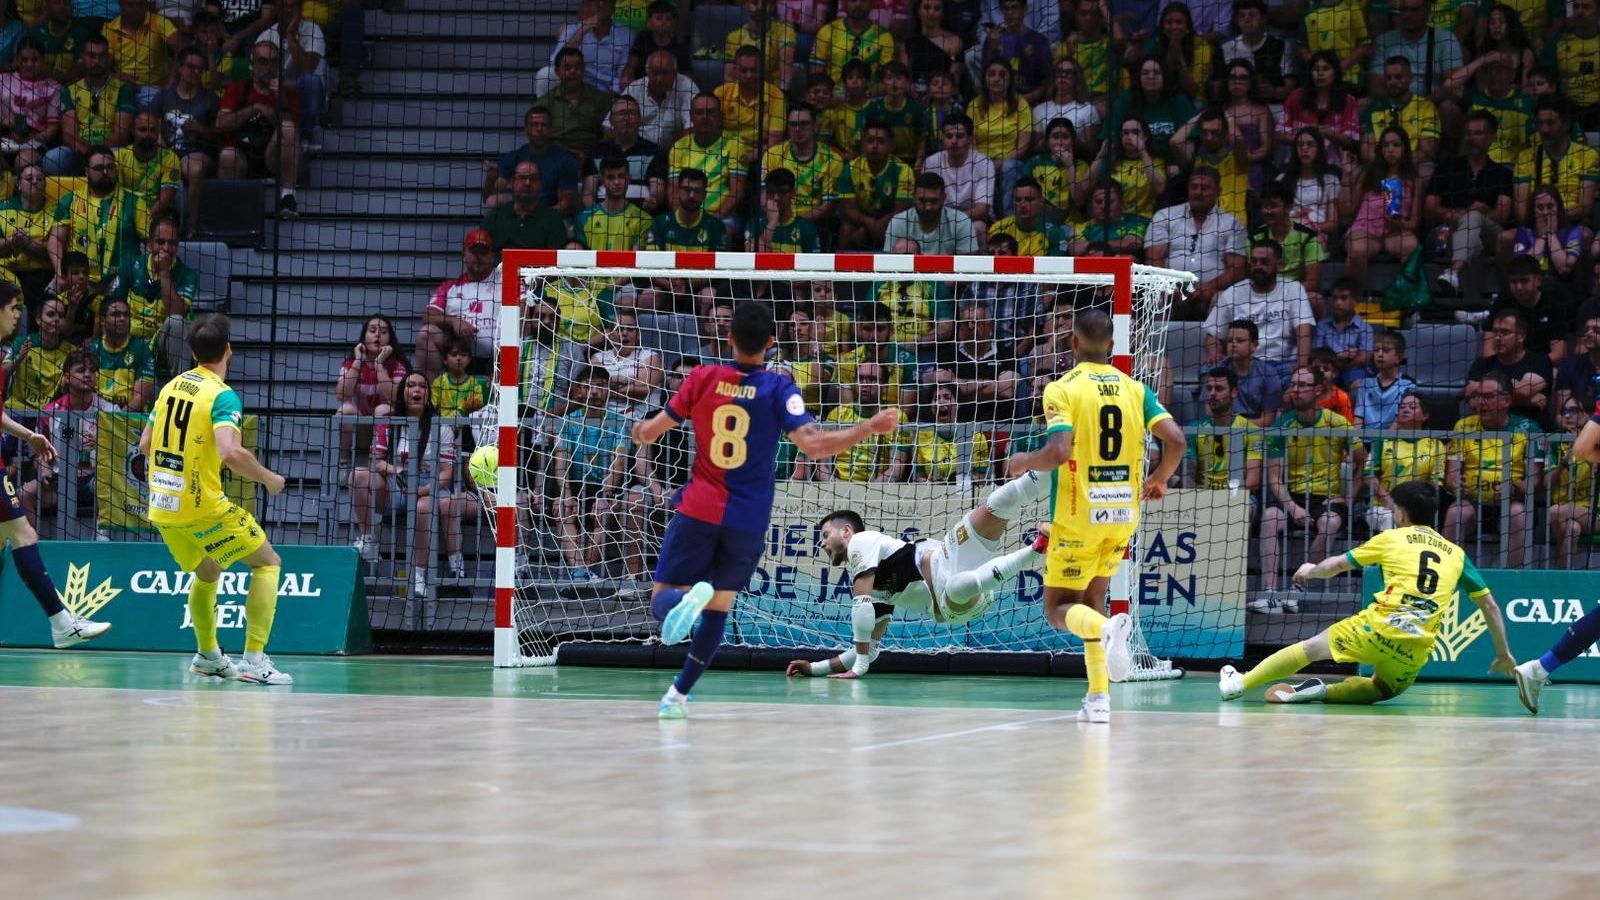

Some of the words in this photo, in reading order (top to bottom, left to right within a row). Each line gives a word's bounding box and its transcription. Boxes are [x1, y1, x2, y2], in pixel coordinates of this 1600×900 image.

[716, 381, 757, 400] ADOLFO
[1097, 384, 1120, 397] SANZ
[162, 396, 194, 451] 14
[710, 404, 750, 469] 8
[1099, 404, 1123, 461] 8
[3, 474, 16, 497] 6
[1406, 534, 1426, 544] DANI
[1427, 536, 1453, 555] ZURDO
[217, 572, 321, 597] RUAL
[743, 567, 797, 599] DE
[815, 567, 852, 603] JA
[1018, 570, 1044, 602] D
[1416, 550, 1441, 595] 6
[180, 601, 247, 629] JÉ
[1506, 598, 1584, 625] CAJA
